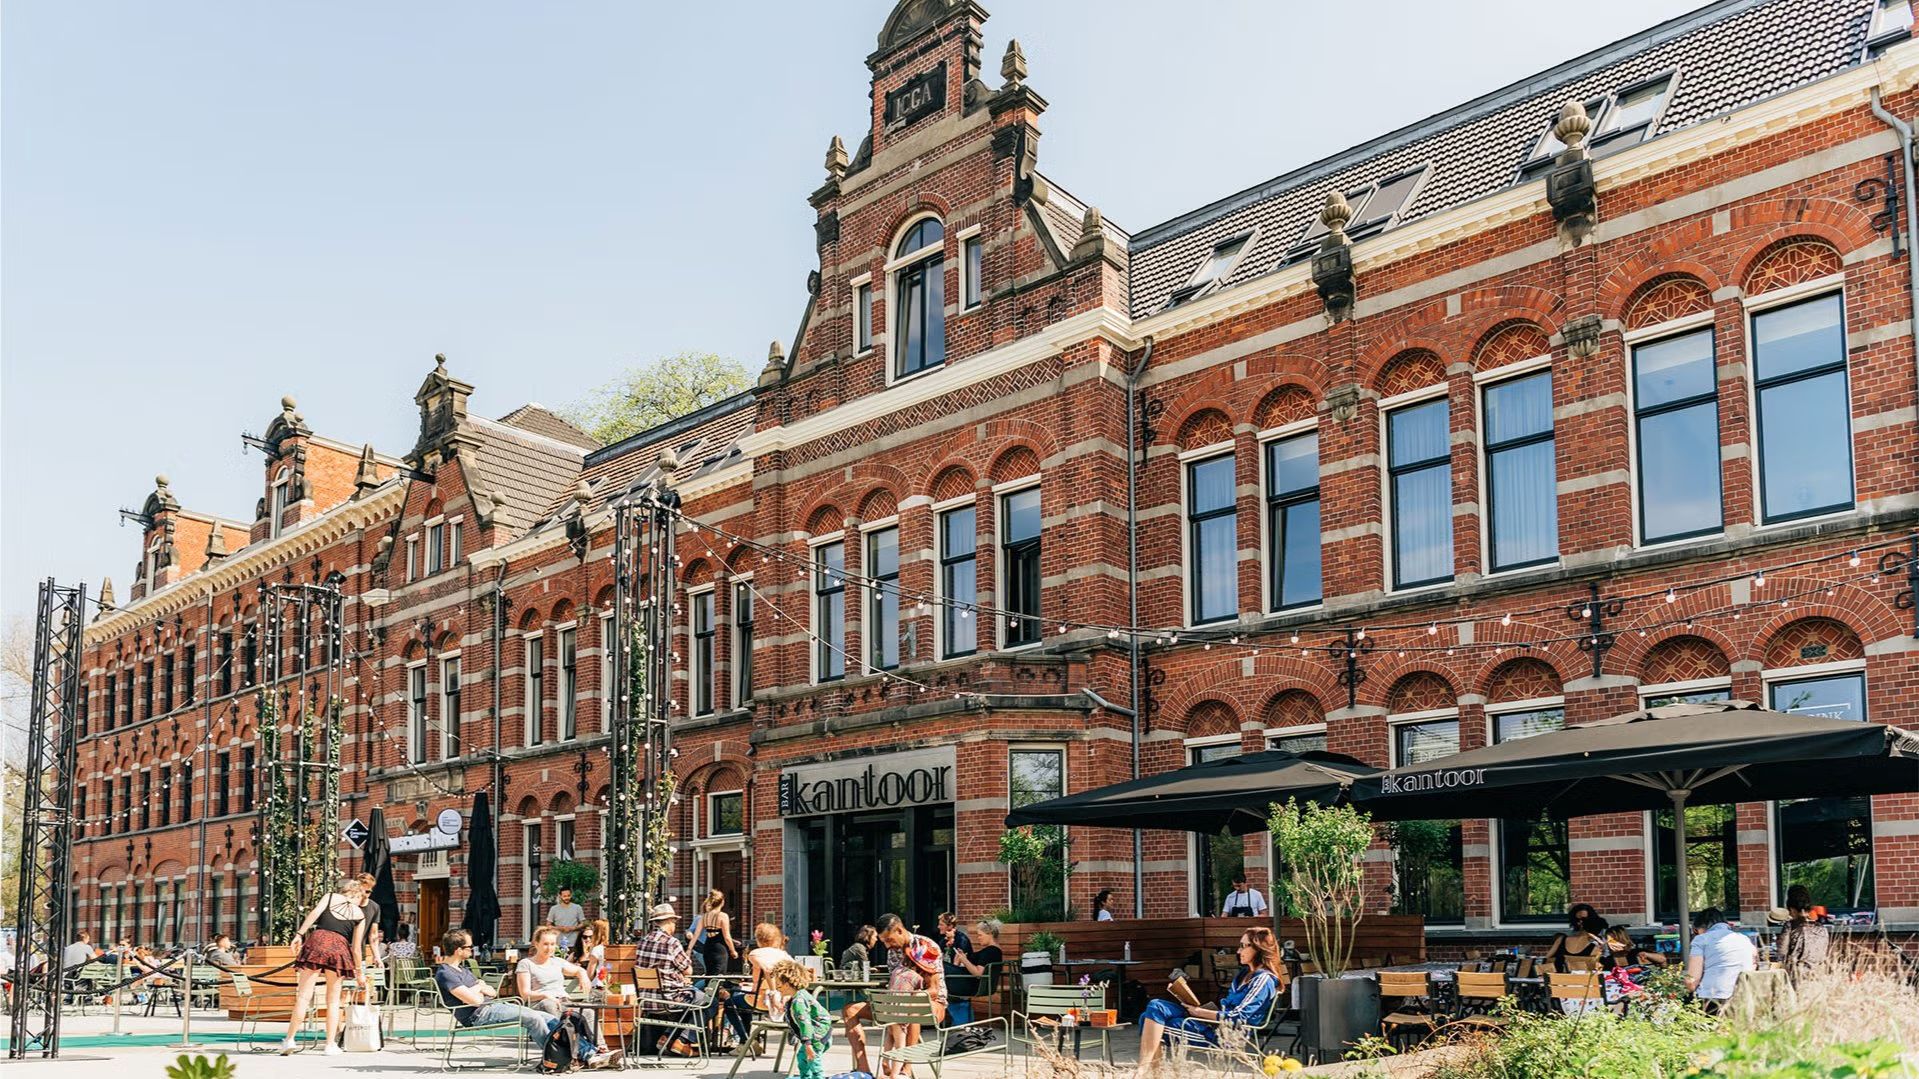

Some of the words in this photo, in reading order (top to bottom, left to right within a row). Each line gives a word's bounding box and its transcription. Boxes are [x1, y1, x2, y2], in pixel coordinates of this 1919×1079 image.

[781, 782, 789, 808] BAR
[788, 764, 951, 815] kantoor
[1390, 768, 1487, 793] kantoor
